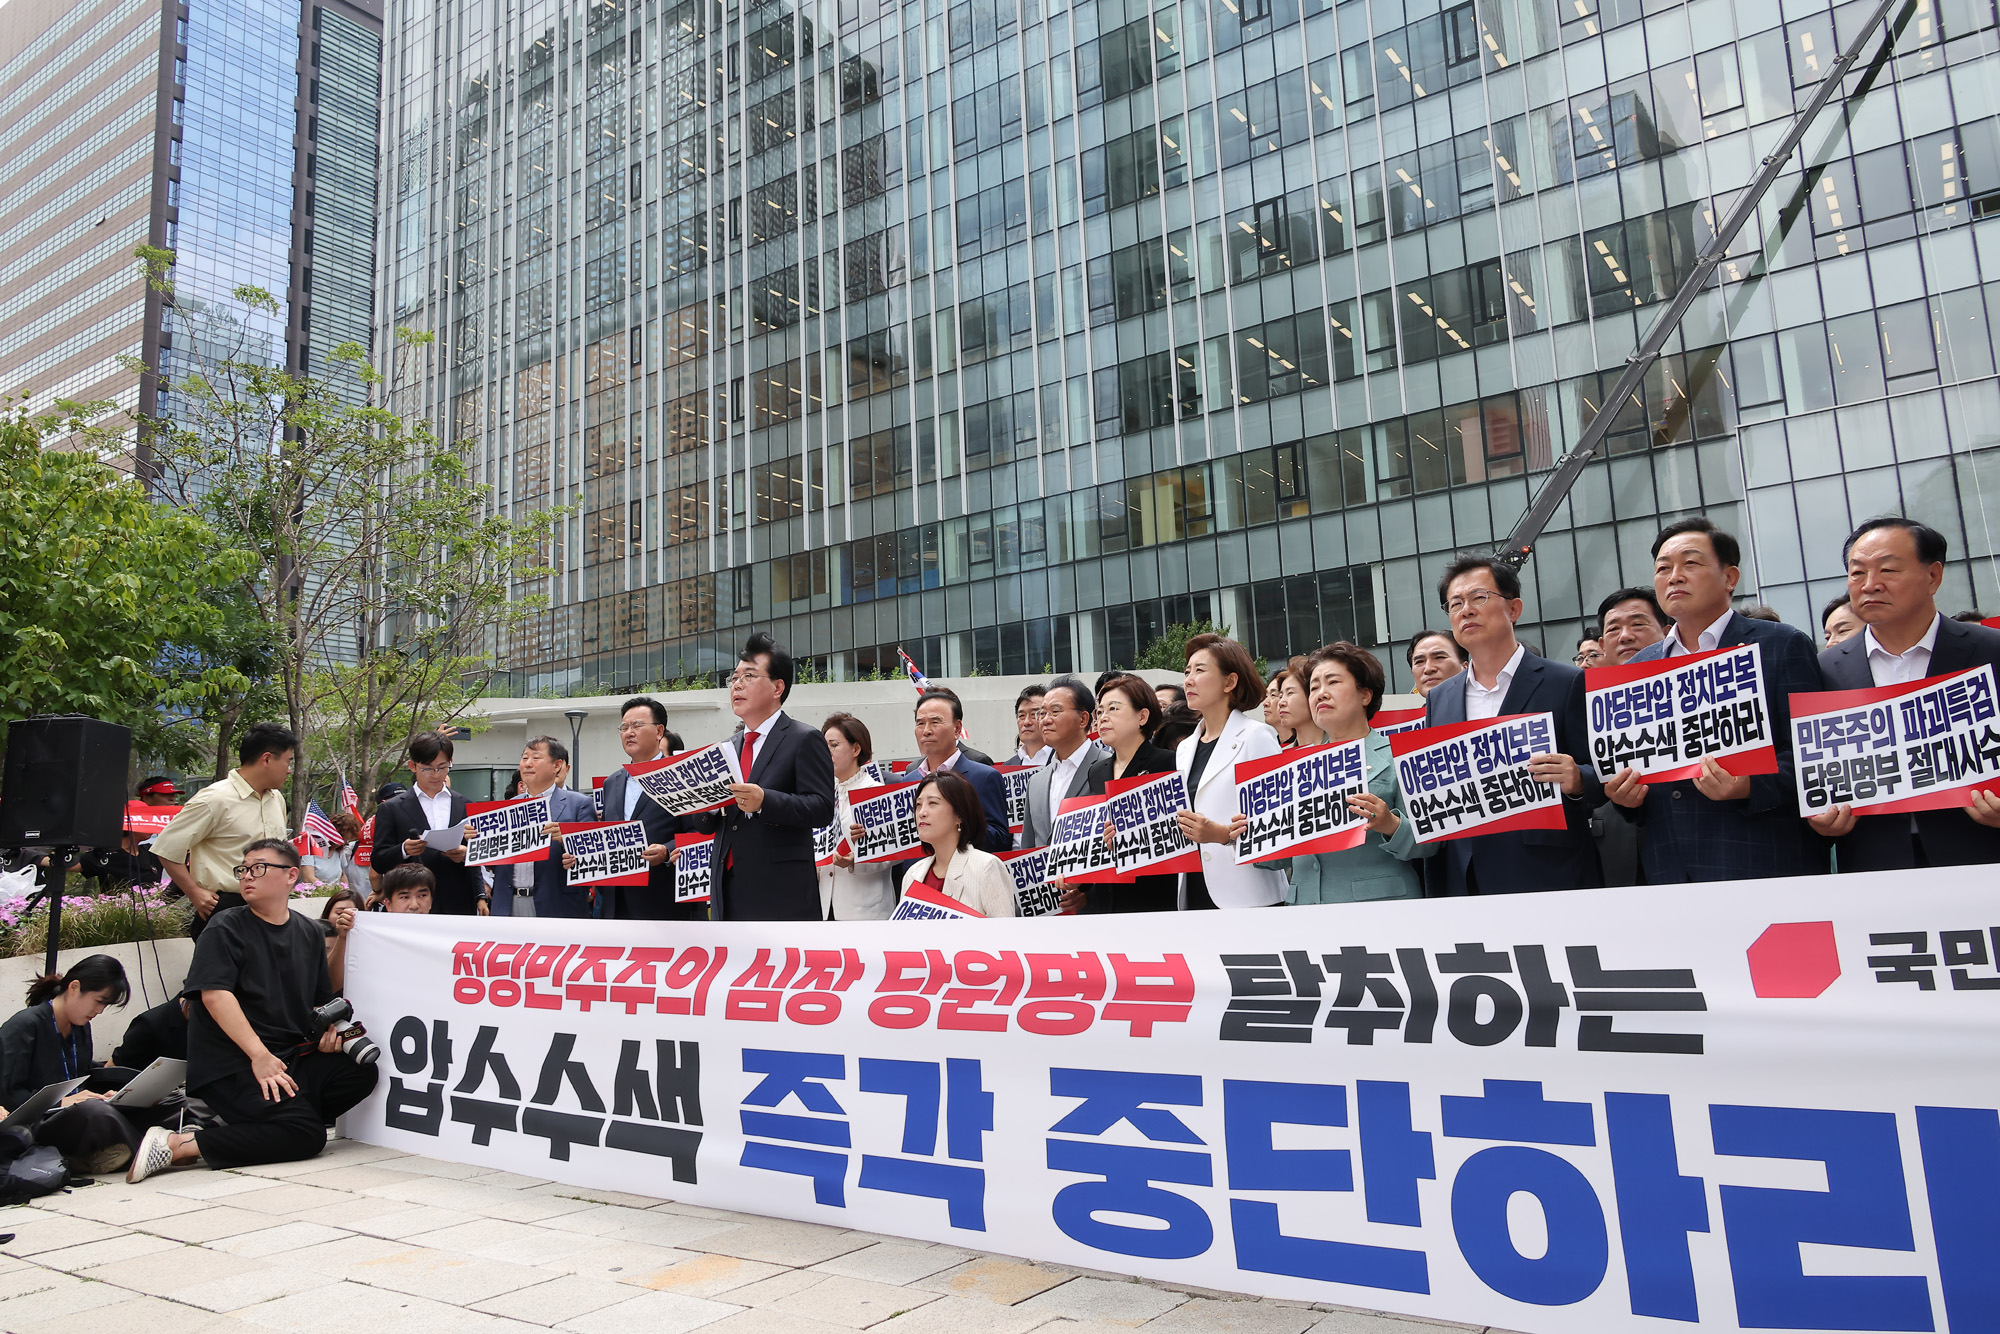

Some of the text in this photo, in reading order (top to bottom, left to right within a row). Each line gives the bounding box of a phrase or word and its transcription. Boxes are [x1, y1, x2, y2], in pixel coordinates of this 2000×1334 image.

[1591, 650, 1757, 733] 야당탄압 정치보복
[1594, 697, 1765, 777] 압수수색 중단하라
[1797, 672, 1996, 762] 민주주의 파괴특검
[638, 746, 731, 796] 야당탄압 정치보복
[1239, 744, 1362, 818] 야당탄압 정치보복
[1400, 718, 1550, 796] 야당탄압 정치보복
[1802, 724, 2000, 809] 당원명부 절대사수
[470, 800, 549, 839] 민주주의 파괴특검
[657, 790, 708, 813] 압수수색
[853, 796, 894, 829] 야당탄압
[1143, 775, 1187, 821] 정치보복
[1409, 781, 1486, 836] 압수수색
[468, 833, 509, 862] 당원명부
[565, 823, 645, 856] 야당탄압 정치보복
[857, 823, 898, 858] 압수수색
[1053, 807, 1096, 845] 야당탄압
[1239, 804, 1295, 857] 압수수색
[570, 853, 608, 881] 압수수색
[1047, 839, 1091, 877] 압수수색
[451, 940, 1708, 1054] 정당민주주의 심장 당원명부 탈취하는
[344, 1028, 362, 1038] EOS
[384, 1015, 704, 1184] 압수수색
[739, 1046, 995, 1233] 즉각
